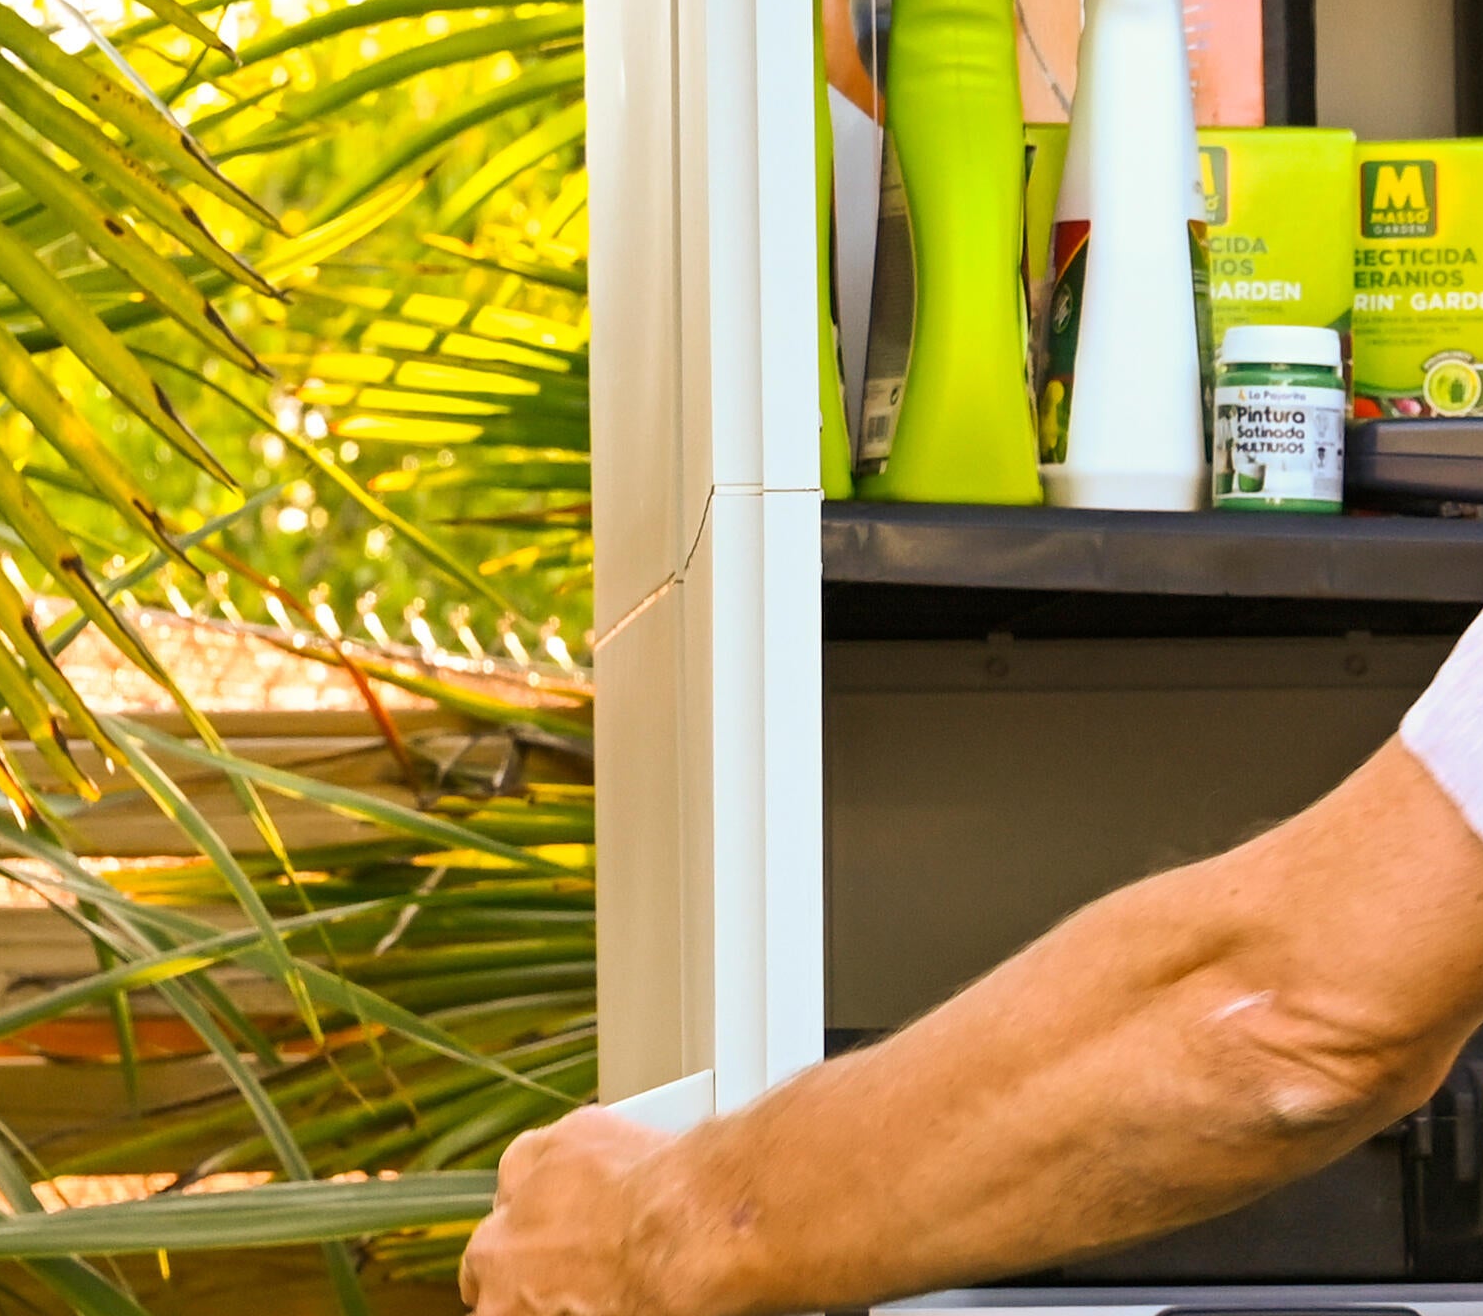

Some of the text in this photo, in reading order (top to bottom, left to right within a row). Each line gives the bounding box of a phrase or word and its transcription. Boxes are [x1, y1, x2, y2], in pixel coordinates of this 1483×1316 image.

[1373, 165, 1427, 210] M
[1374, 225, 1427, 235] GARDEN
[1210, 282, 1302, 301] ARDEN
[1237, 406, 1305, 424] Pintura
[1237, 426, 1305, 440] Satinada
[1236, 442, 1305, 454] MULTIUSOS
